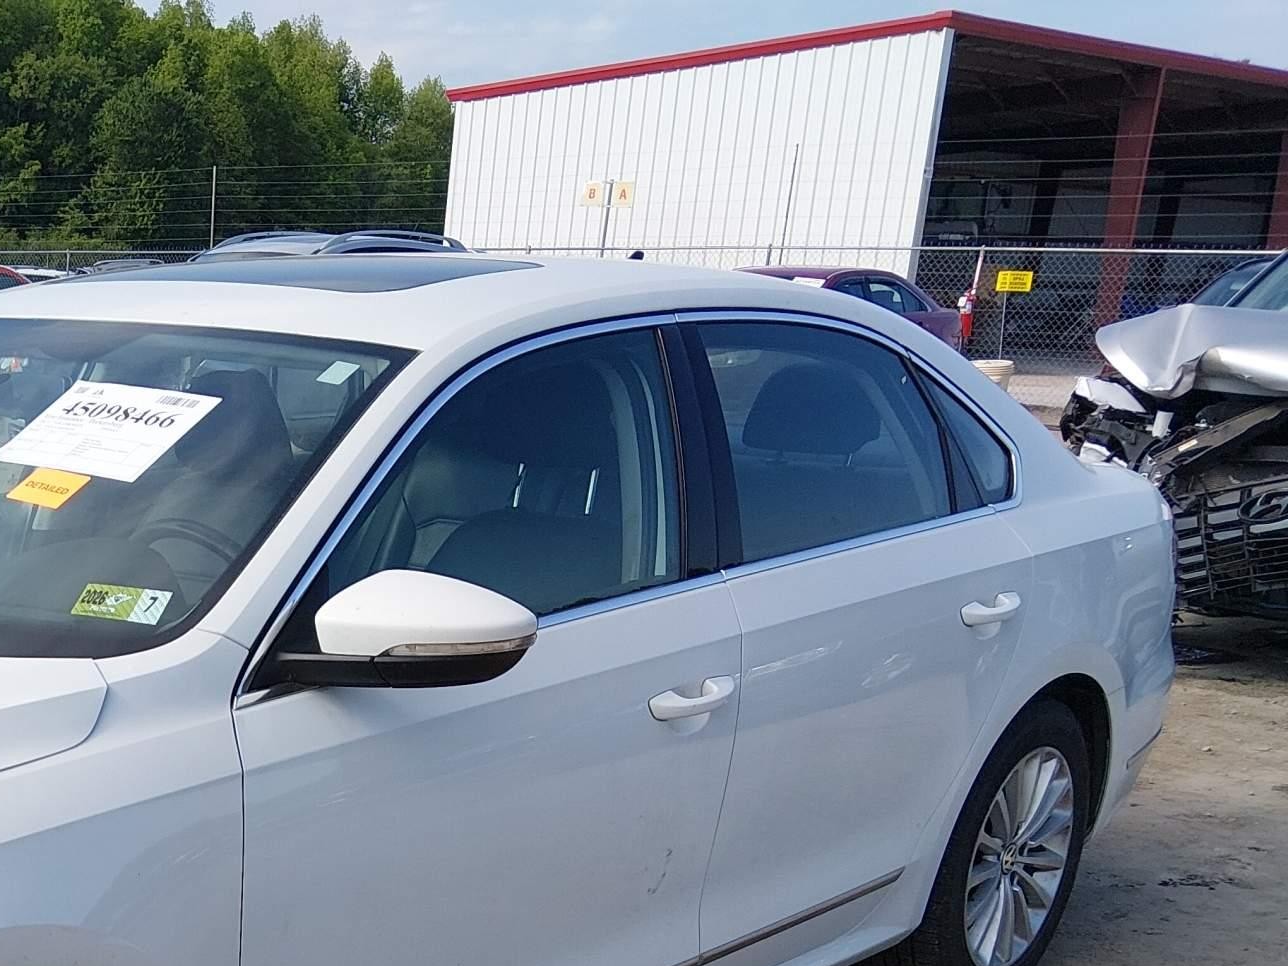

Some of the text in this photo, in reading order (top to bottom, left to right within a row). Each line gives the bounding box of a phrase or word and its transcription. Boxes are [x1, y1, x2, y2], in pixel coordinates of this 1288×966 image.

[588, 188, 596, 199] B
[619, 188, 627, 200] A
[62, 400, 184, 428] 45098466
[25, 480, 70, 495] DETAILED
[80, 589, 109, 605] 2026
[143, 596, 159, 613] 7
